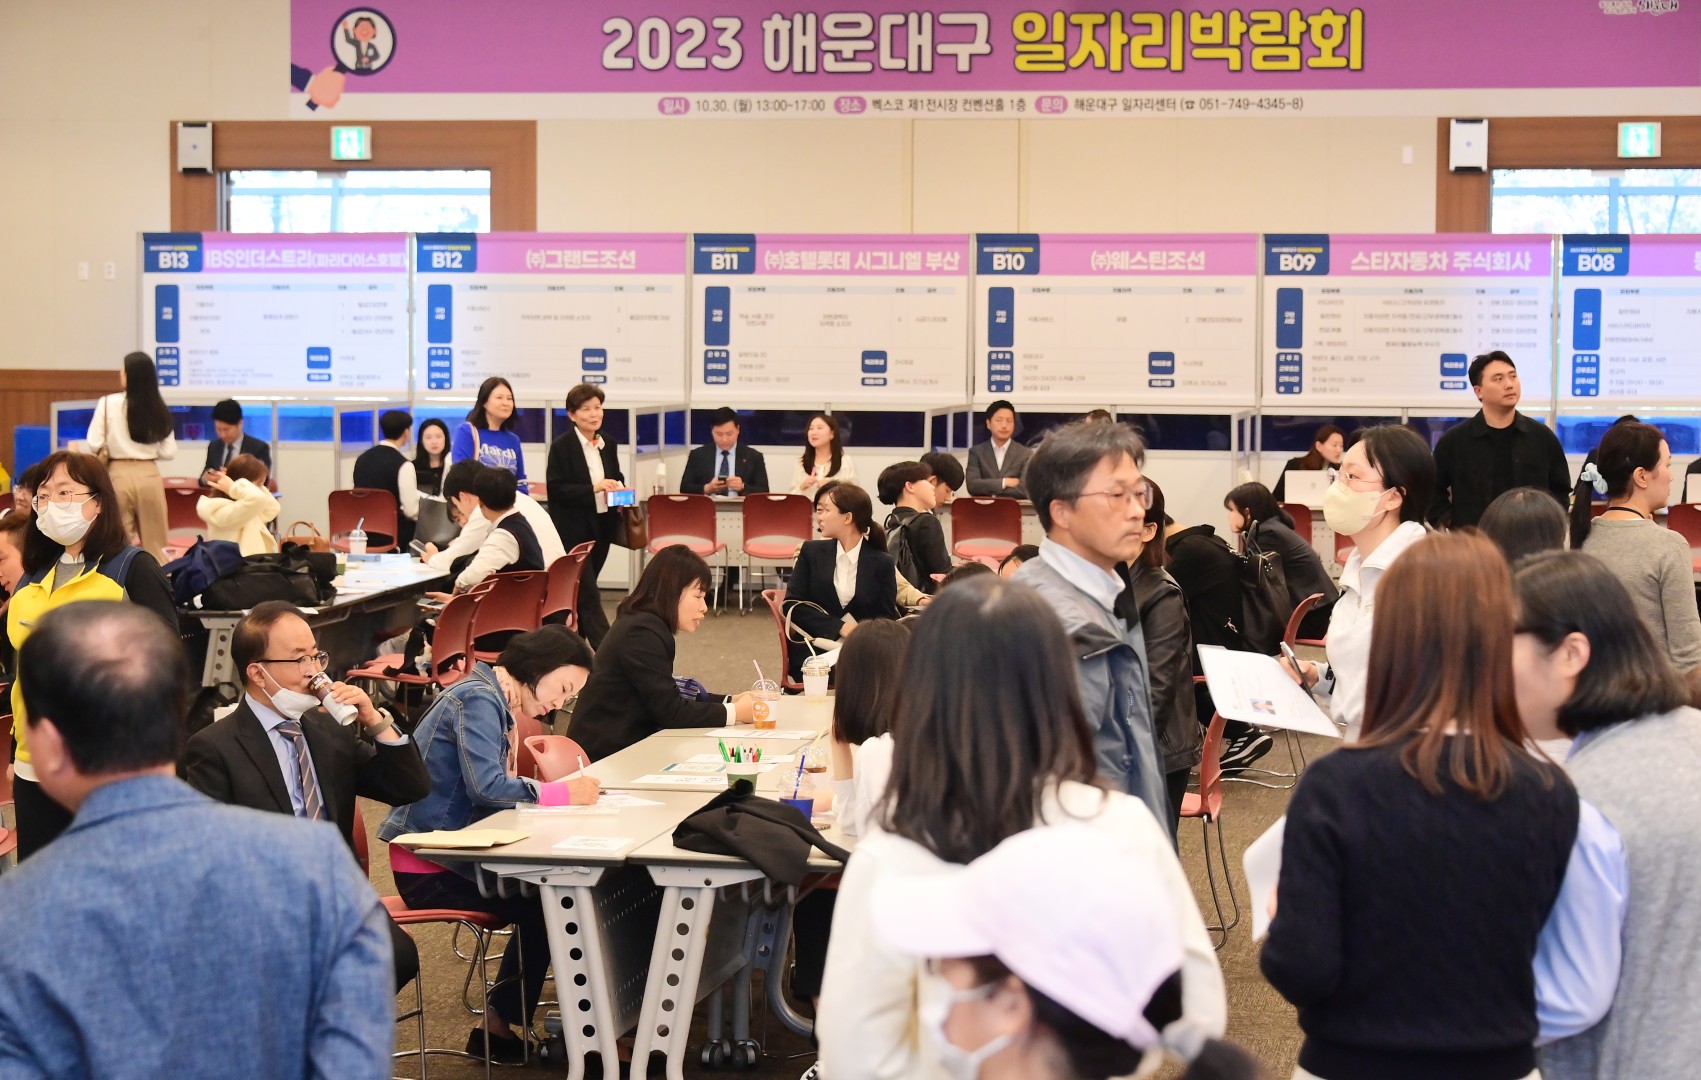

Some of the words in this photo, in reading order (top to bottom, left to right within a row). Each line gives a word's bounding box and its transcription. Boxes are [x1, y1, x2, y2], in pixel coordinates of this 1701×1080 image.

[602, 16, 744, 71] 2023
[762, 12, 992, 73] 해운대구
[1012, 9, 1364, 72] 일자리박람회
[696, 99, 730, 112] 10.30.
[871, 98, 904, 112] 벡스코
[908, 98, 958, 112] 제1전시장
[962, 98, 1005, 112] 컨벤션홀
[1010, 98, 1026, 112] 1층
[1074, 98, 1118, 112] 해운대구
[1121, 97, 1177, 112] 일자리센터
[159, 251, 190, 269] B13
[432, 251, 463, 269] B12
[711, 252, 739, 271] B11
[854, 251, 922, 271] 시그니엘
[925, 251, 961, 271] 부산
[992, 253, 1026, 271] B10
[1279, 253, 1317, 272] B09
[1350, 251, 1449, 272] 스타자동차
[1453, 251, 1532, 272] 주식회사
[1577, 253, 1616, 272] B08
